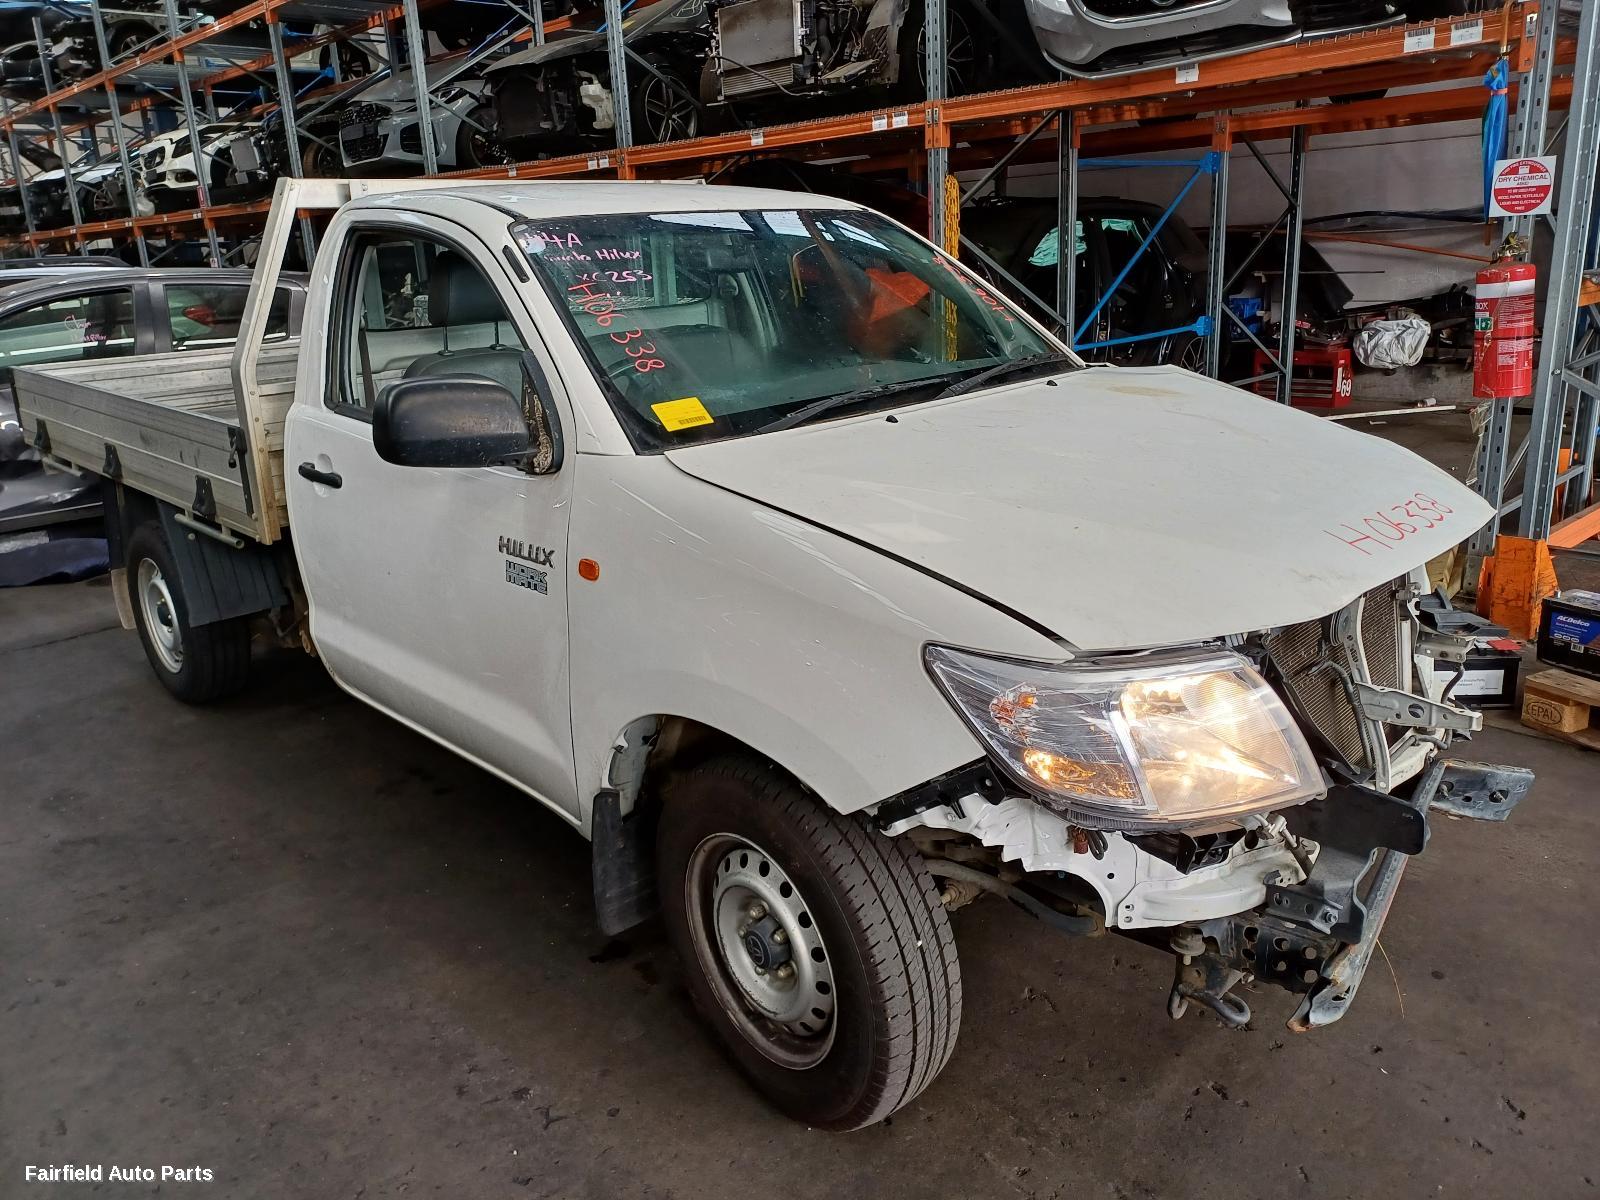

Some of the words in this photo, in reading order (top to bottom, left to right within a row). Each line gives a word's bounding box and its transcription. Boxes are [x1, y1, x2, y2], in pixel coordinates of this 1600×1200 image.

[1513, 174, 1548, 182] CHEMICAL
[1322, 492, 1454, 556] H06338
[498, 535, 556, 569] HILUX
[1556, 615, 1591, 628] ACDelco
[1531, 703, 1558, 723] EPAL
